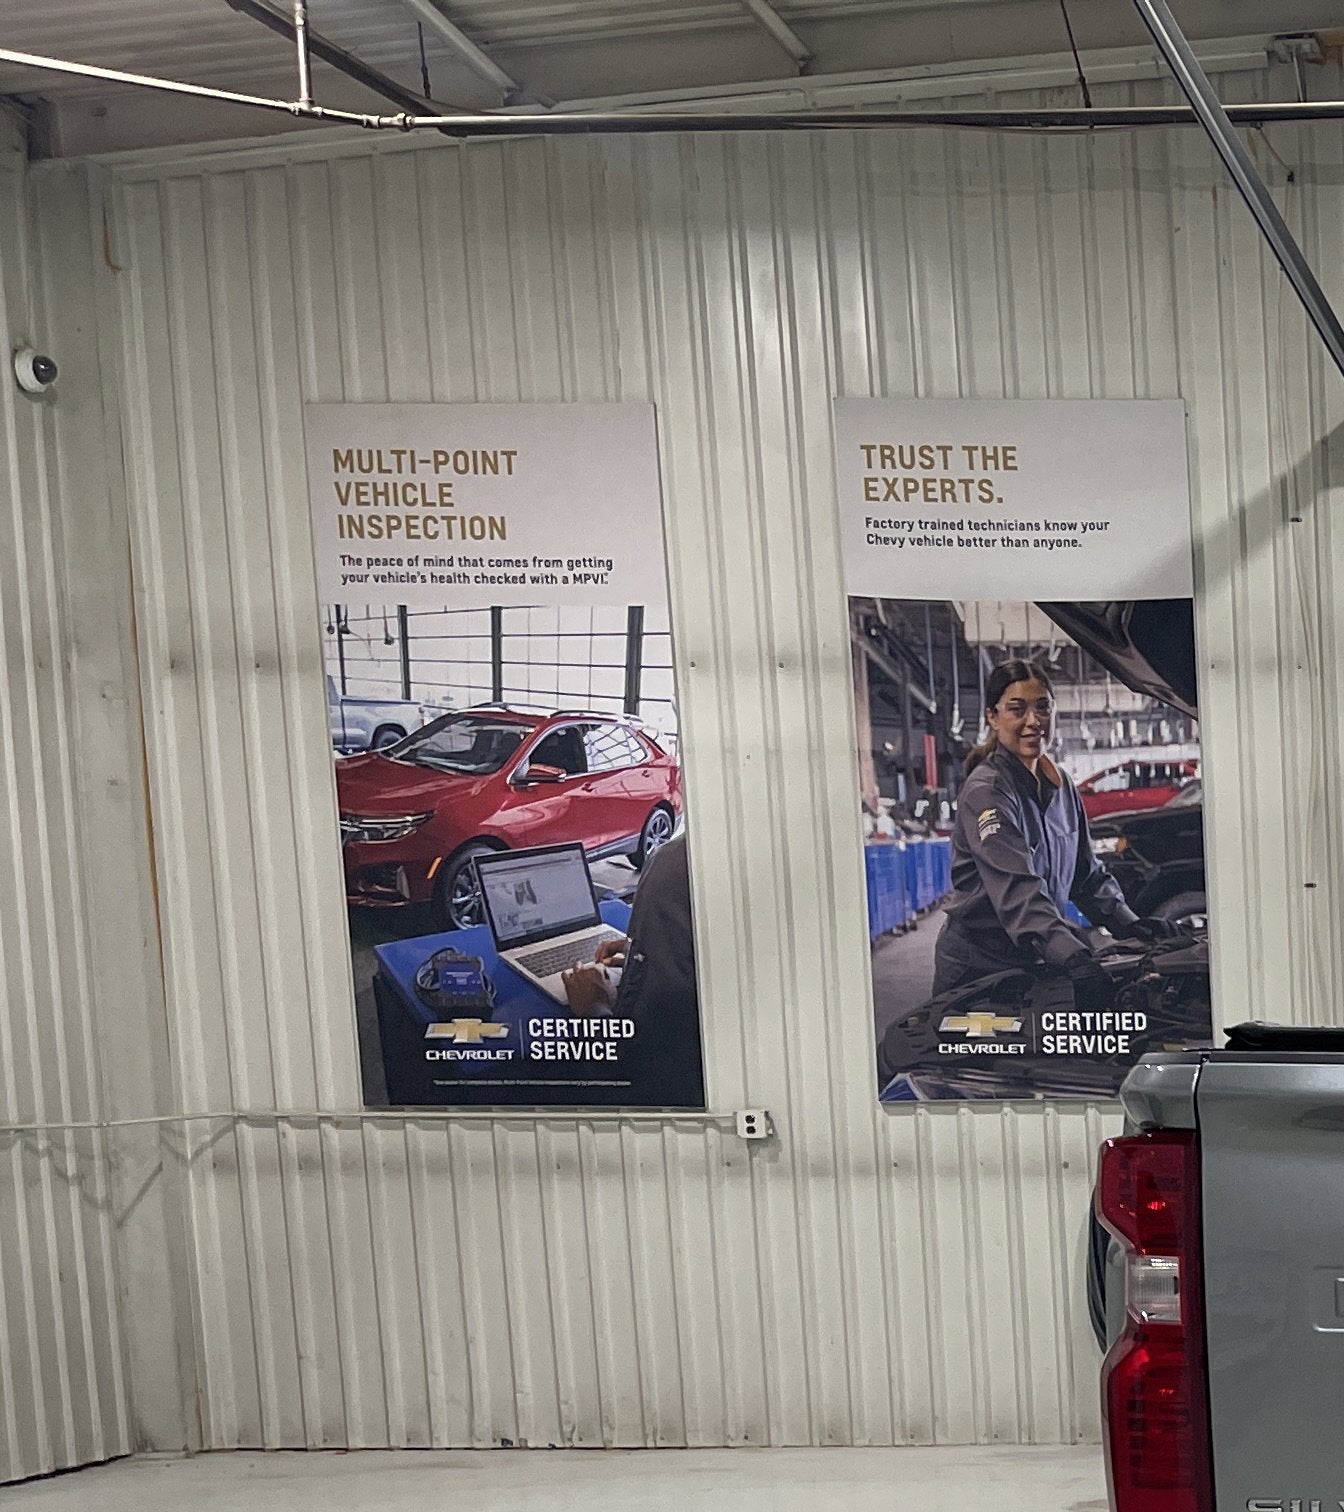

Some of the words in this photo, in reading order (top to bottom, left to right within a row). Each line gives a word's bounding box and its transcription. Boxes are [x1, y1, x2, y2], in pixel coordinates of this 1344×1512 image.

[332, 448, 518, 476] MULTI-POINT
[859, 444, 954, 471] TRUST
[961, 445, 1019, 471] THE
[333, 481, 455, 508] VEHICLE
[863, 476, 1004, 504] EXPERTS.
[337, 513, 507, 541] INSPECTION
[865, 516, 915, 533] Factory
[917, 518, 964, 531] trained
[967, 519, 1041, 532] technicians
[1043, 519, 1078, 532] know
[1080, 521, 1110, 534] your
[866, 533, 906, 549] Chevy
[908, 534, 954, 547] vehicle
[957, 535, 998, 548] better
[1000, 535, 1030, 548] than
[1033, 538, 1082, 551] anyone.
[339, 554, 363, 567] The
[366, 557, 404, 570] peace
[406, 554, 420, 567] of
[423, 555, 454, 568] mind
[457, 555, 485, 568] that
[487, 558, 529, 568] comes
[532, 555, 563, 568] from
[566, 557, 613, 572] getting
[341, 573, 370, 586] your
[372, 571, 427, 584] vehicle's
[430, 571, 471, 585] health
[473, 572, 527, 585] checked
[529, 572, 558, 585] with
[561, 575, 569, 585] a
[528, 1018, 635, 1038] CERTIFIED
[1041, 1012, 1147, 1032] CERTIFIED
[530, 1040, 618, 1061] SERVICE
[938, 1043, 1027, 1054] CHEVROLET
[1042, 1034, 1130, 1054] SERVICE
[425, 1049, 515, 1061] CHEVROLET
